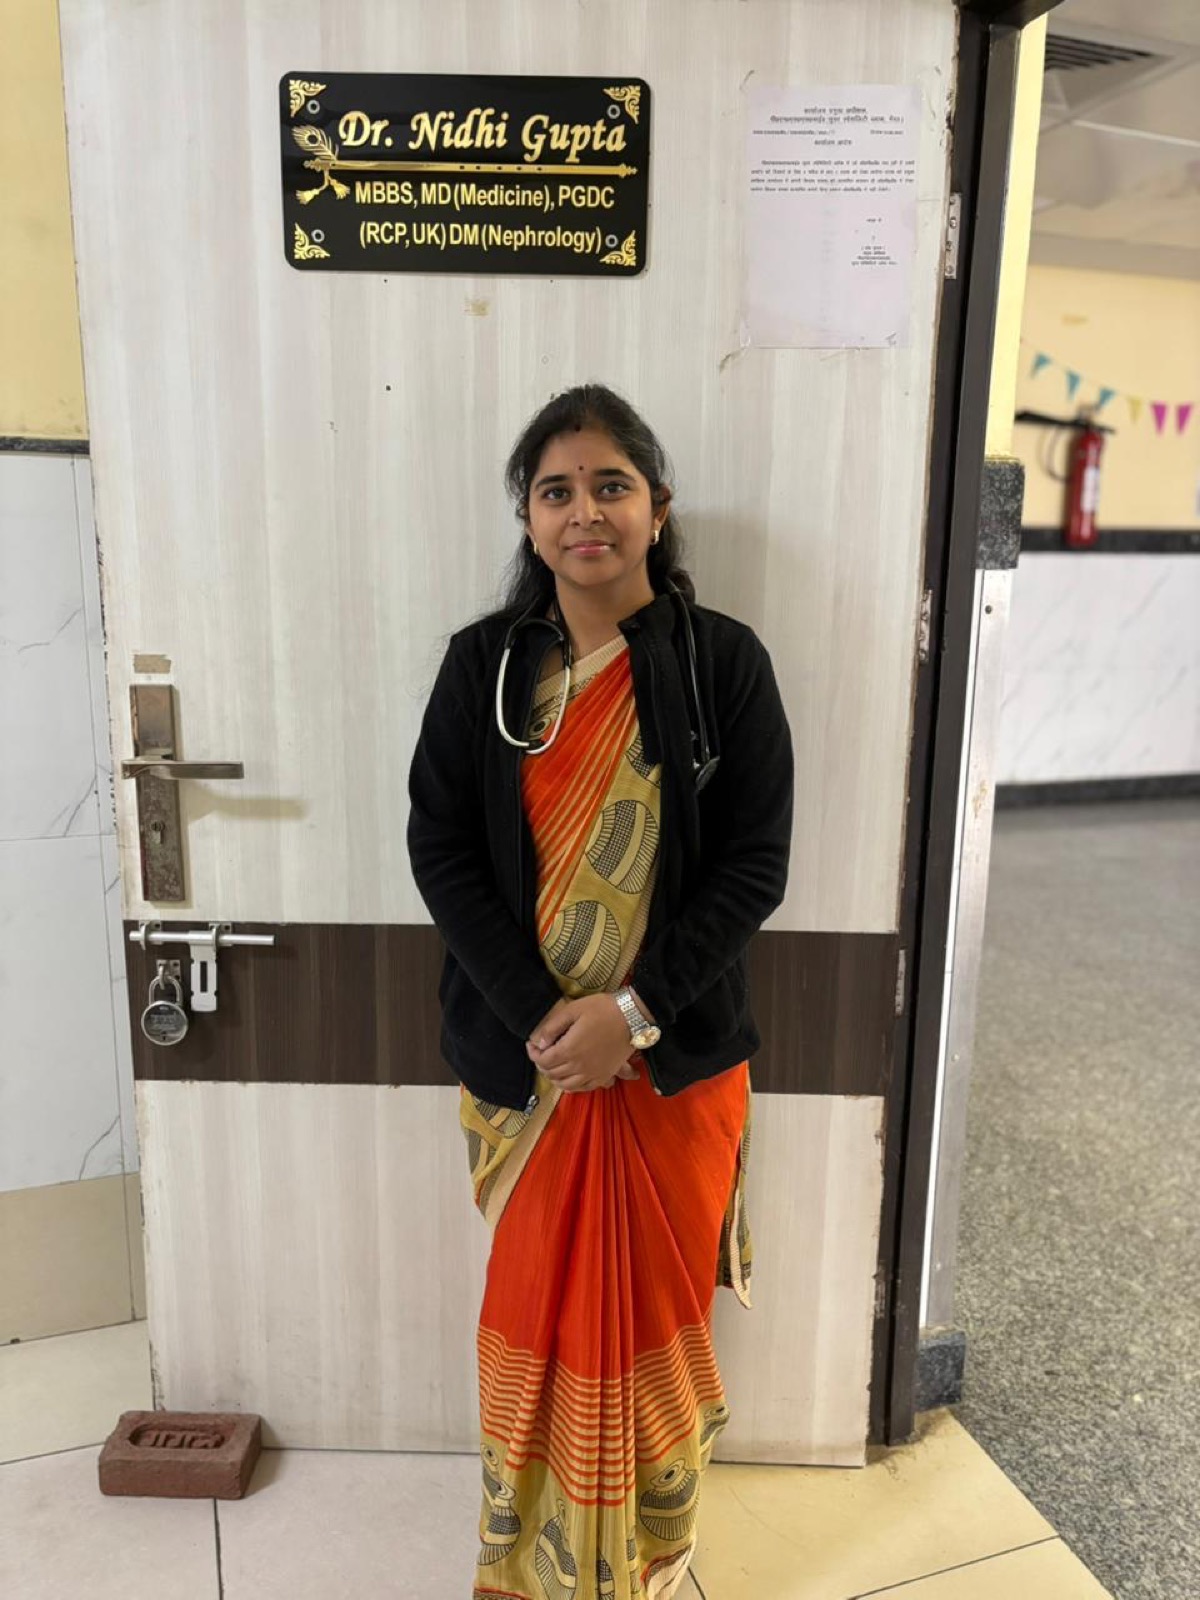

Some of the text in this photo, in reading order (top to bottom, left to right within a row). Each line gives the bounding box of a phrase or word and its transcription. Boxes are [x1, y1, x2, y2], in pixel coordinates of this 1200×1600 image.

[338, 107, 627, 163] Dr. Nidhi Gupta
[354, 180, 419, 210] MBBS,
[558, 184, 615, 209] PGDC
